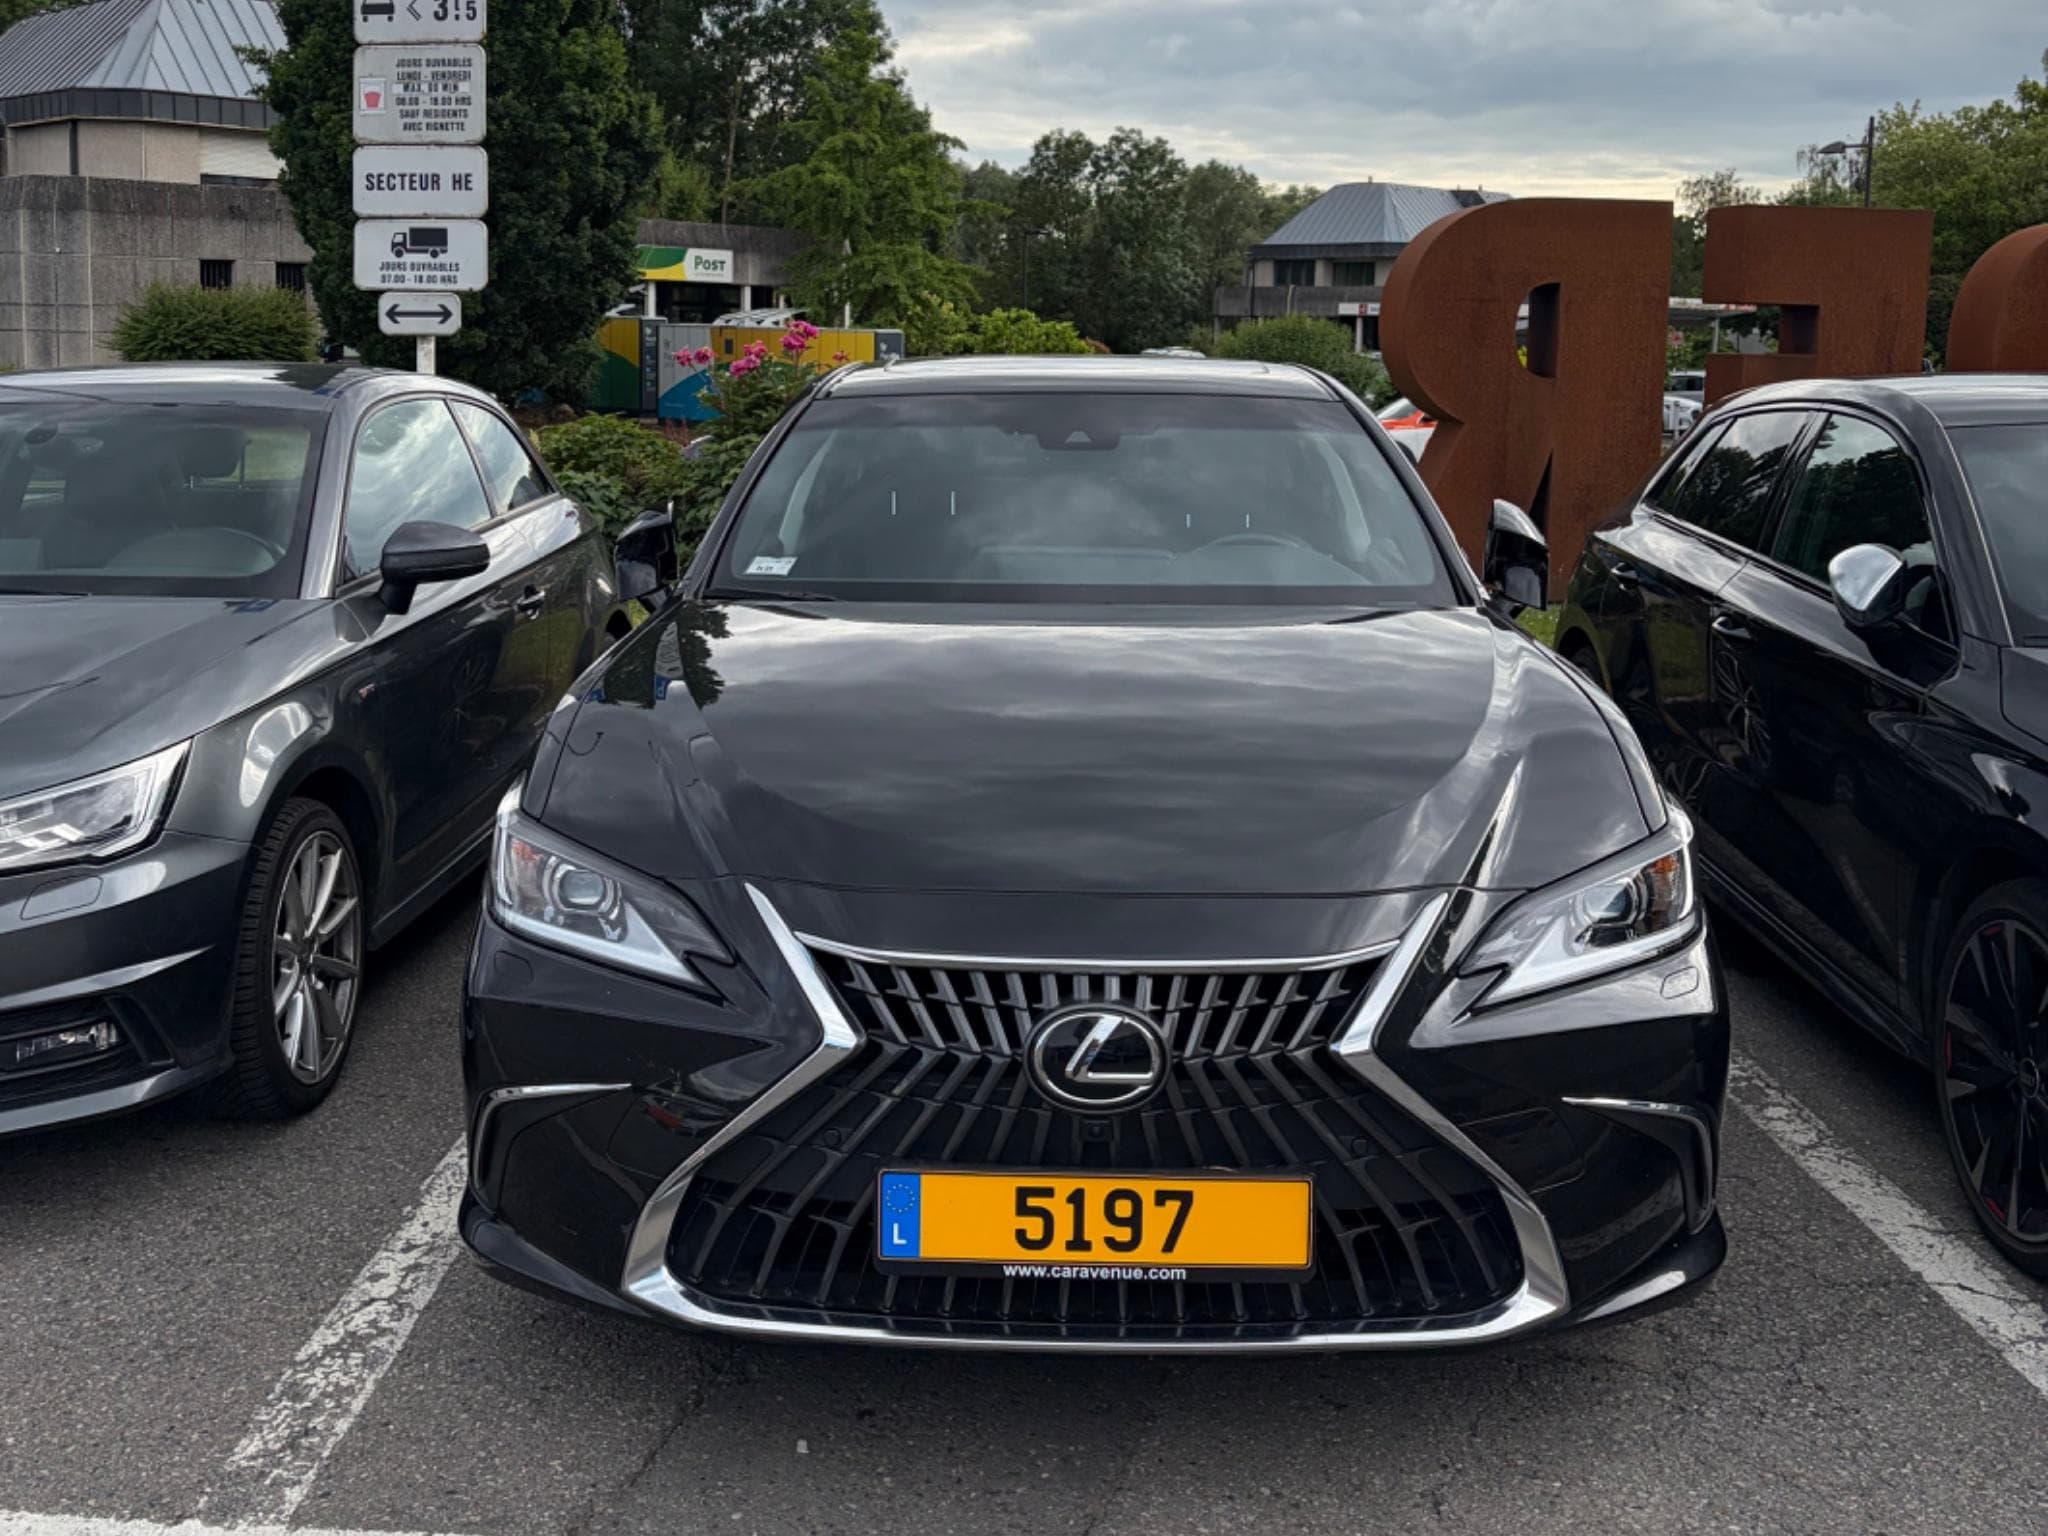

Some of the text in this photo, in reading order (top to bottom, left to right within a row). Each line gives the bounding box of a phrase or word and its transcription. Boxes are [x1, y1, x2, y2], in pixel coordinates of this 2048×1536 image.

[397, 70, 421, 81] LUNDI
[431, 70, 472, 81] VENDREDI
[399, 109, 420, 119] SAUF
[403, 122, 466, 132] AVEC VIGNETTE
[365, 172, 474, 192] SECTEUR HE
[379, 261, 460, 272] JOURS OUVRABLES
[440, 274, 459, 285] HRS
[1014, 1185, 1194, 1253] 5197
[892, 1223, 907, 1245] L
[1002, 1264, 1187, 1282] www.caravenue.com
